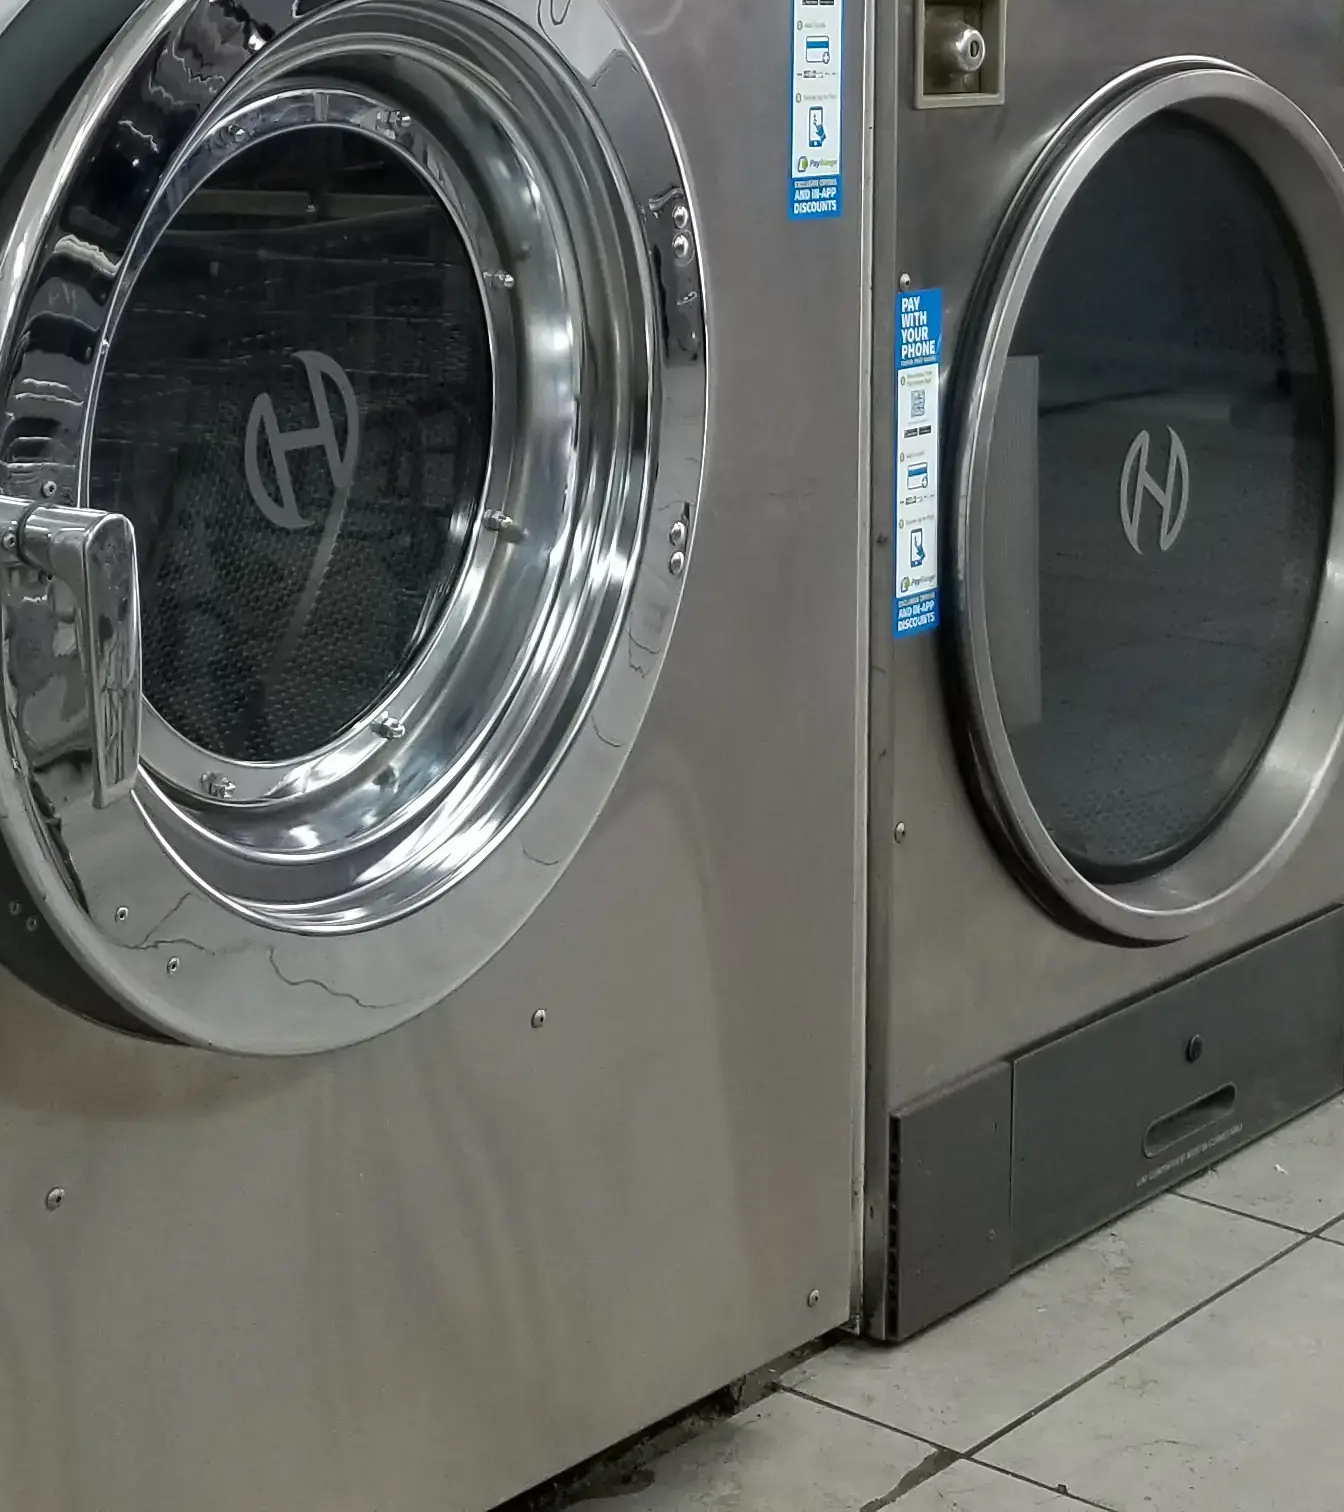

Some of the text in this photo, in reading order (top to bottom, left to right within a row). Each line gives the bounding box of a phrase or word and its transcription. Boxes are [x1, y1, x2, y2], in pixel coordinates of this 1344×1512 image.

[793, 199, 838, 215] DISCOUNTS
[901, 296, 921, 313] PAY
[901, 311, 927, 329] WITH
[901, 326, 929, 344] YOUR
[901, 339, 936, 360] PHONE
